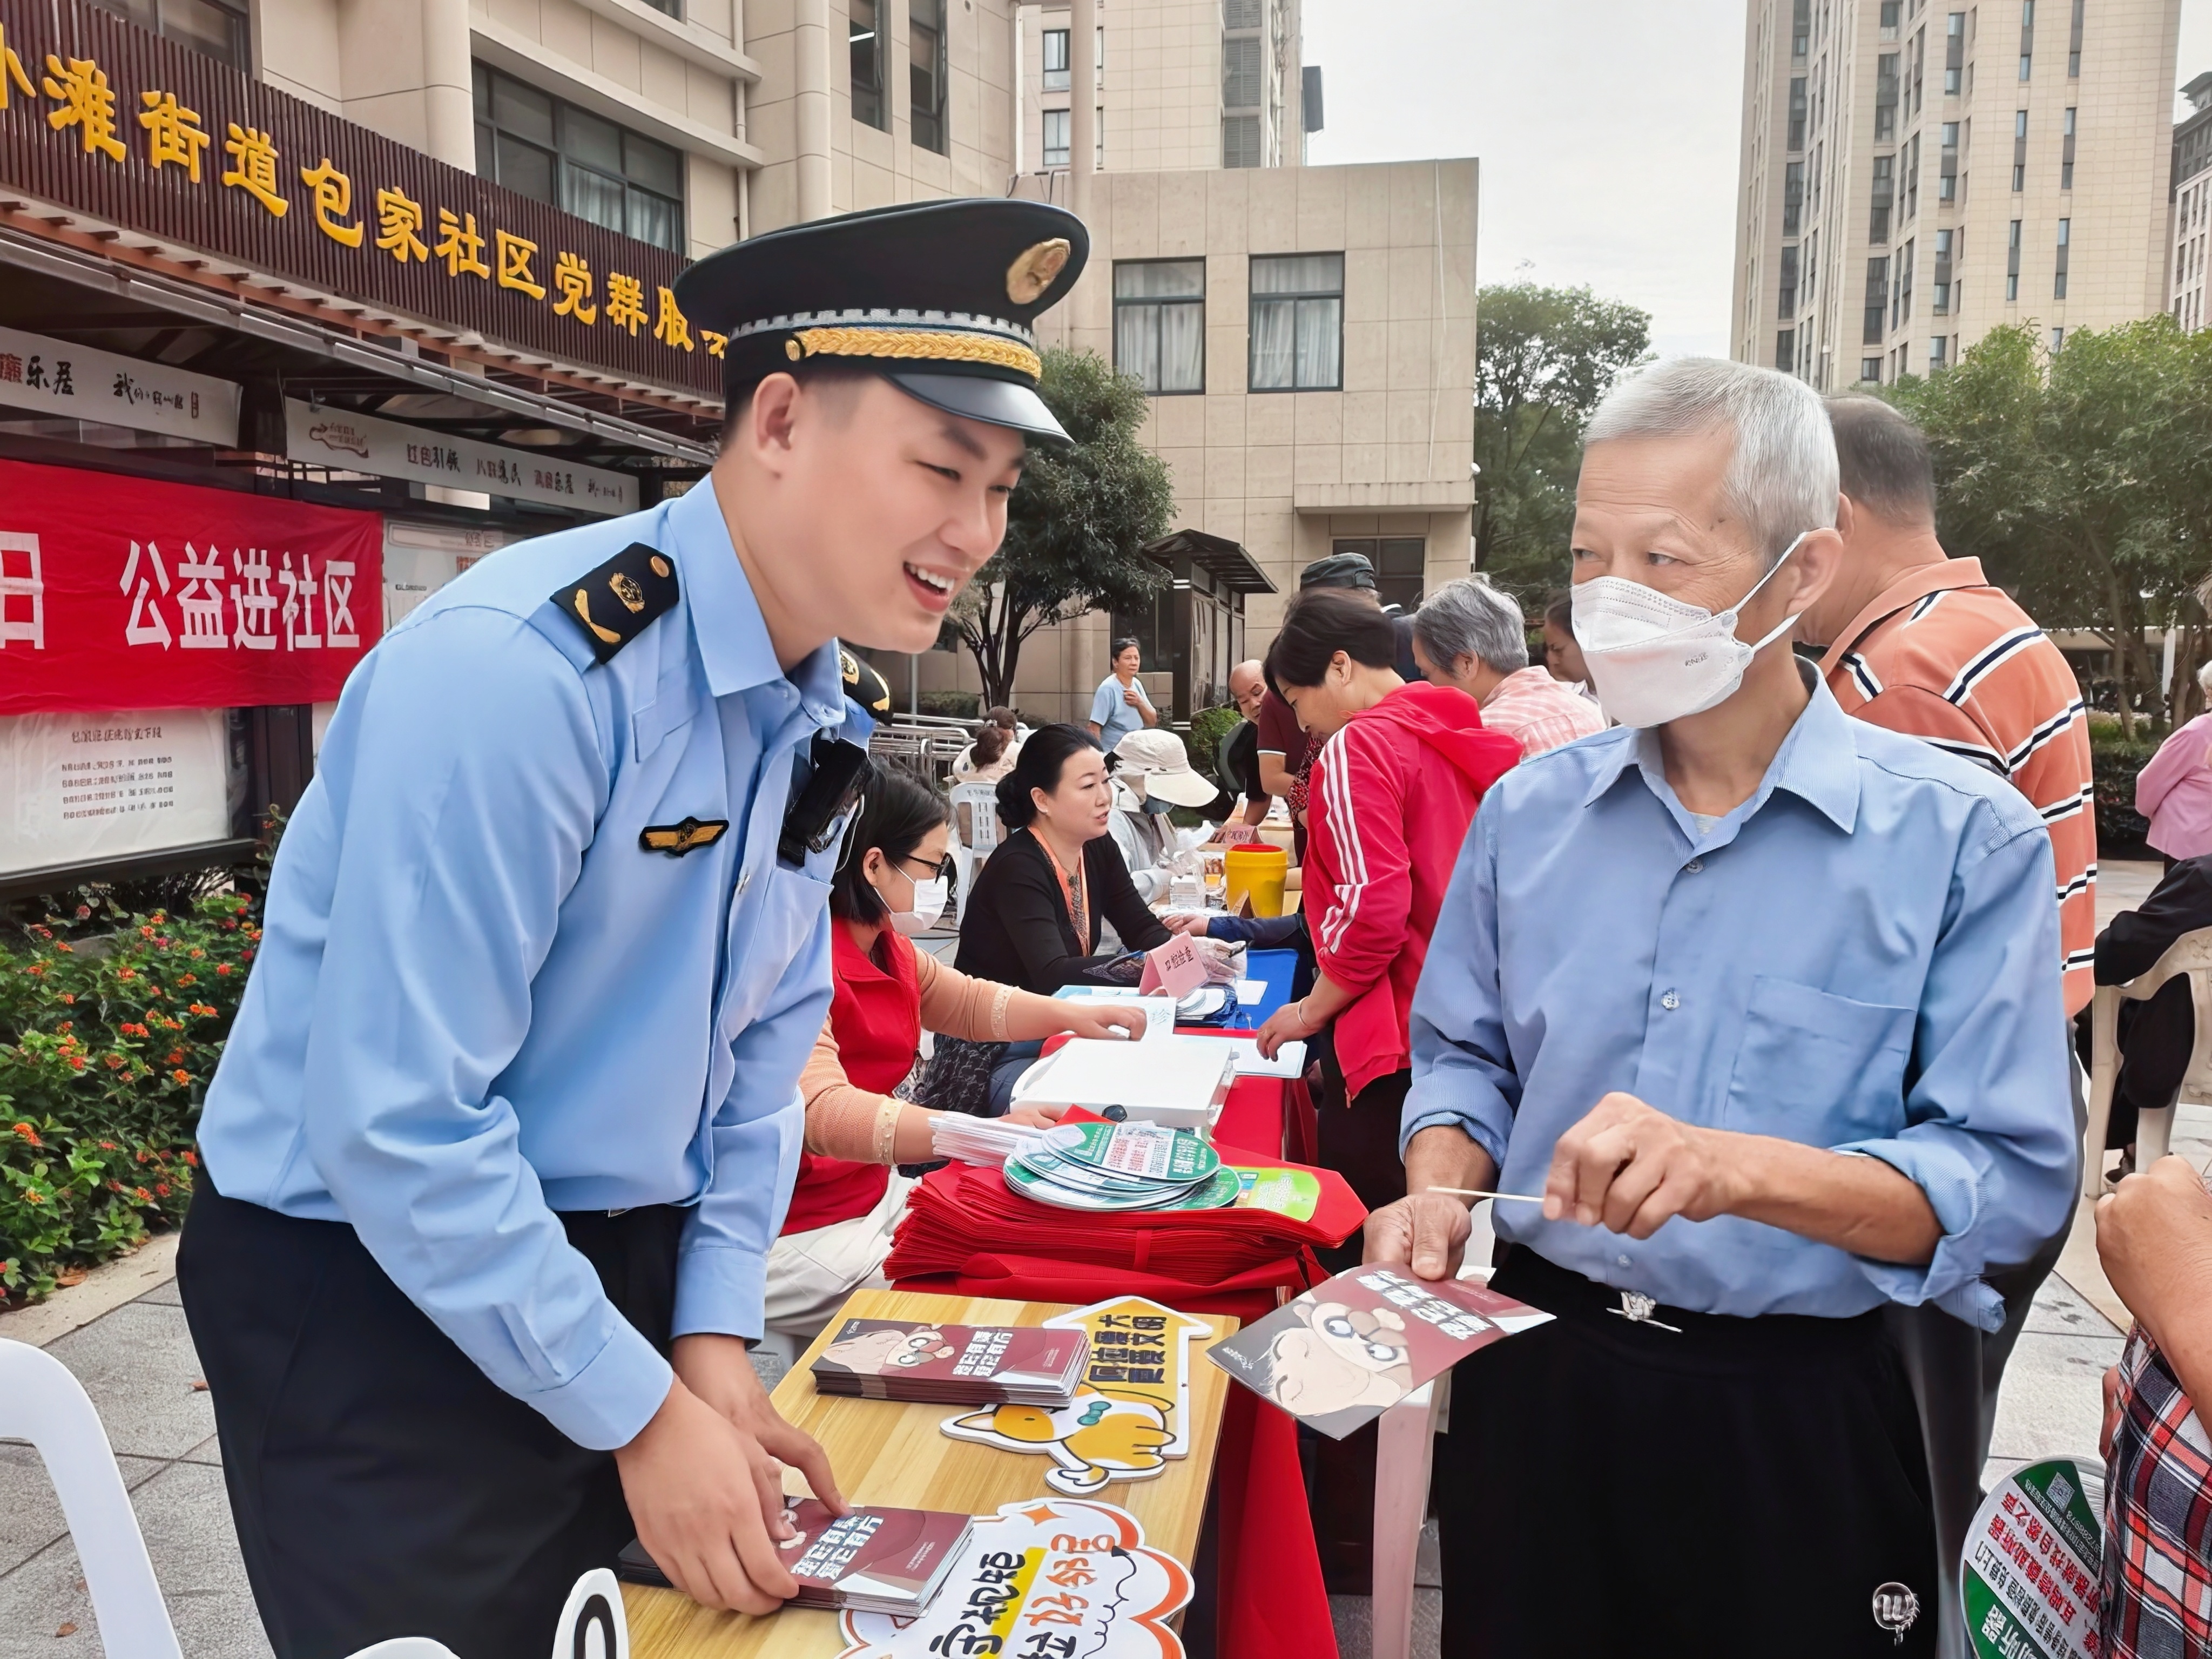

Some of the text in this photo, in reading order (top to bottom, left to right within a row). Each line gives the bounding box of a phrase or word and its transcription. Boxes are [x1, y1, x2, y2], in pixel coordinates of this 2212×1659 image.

[119, 540, 360, 652] 公益进社区
[929, 1552, 1025, 1657] 守规矩
[1975, 1540, 2010, 1590] 免费上门
[1988, 1514, 2101, 1659] 聋、耳鸣请戴助听器
[2001, 1491, 2101, 1617] 听器就找自然之声
[2006, 1575, 2041, 1625] 免费检查
